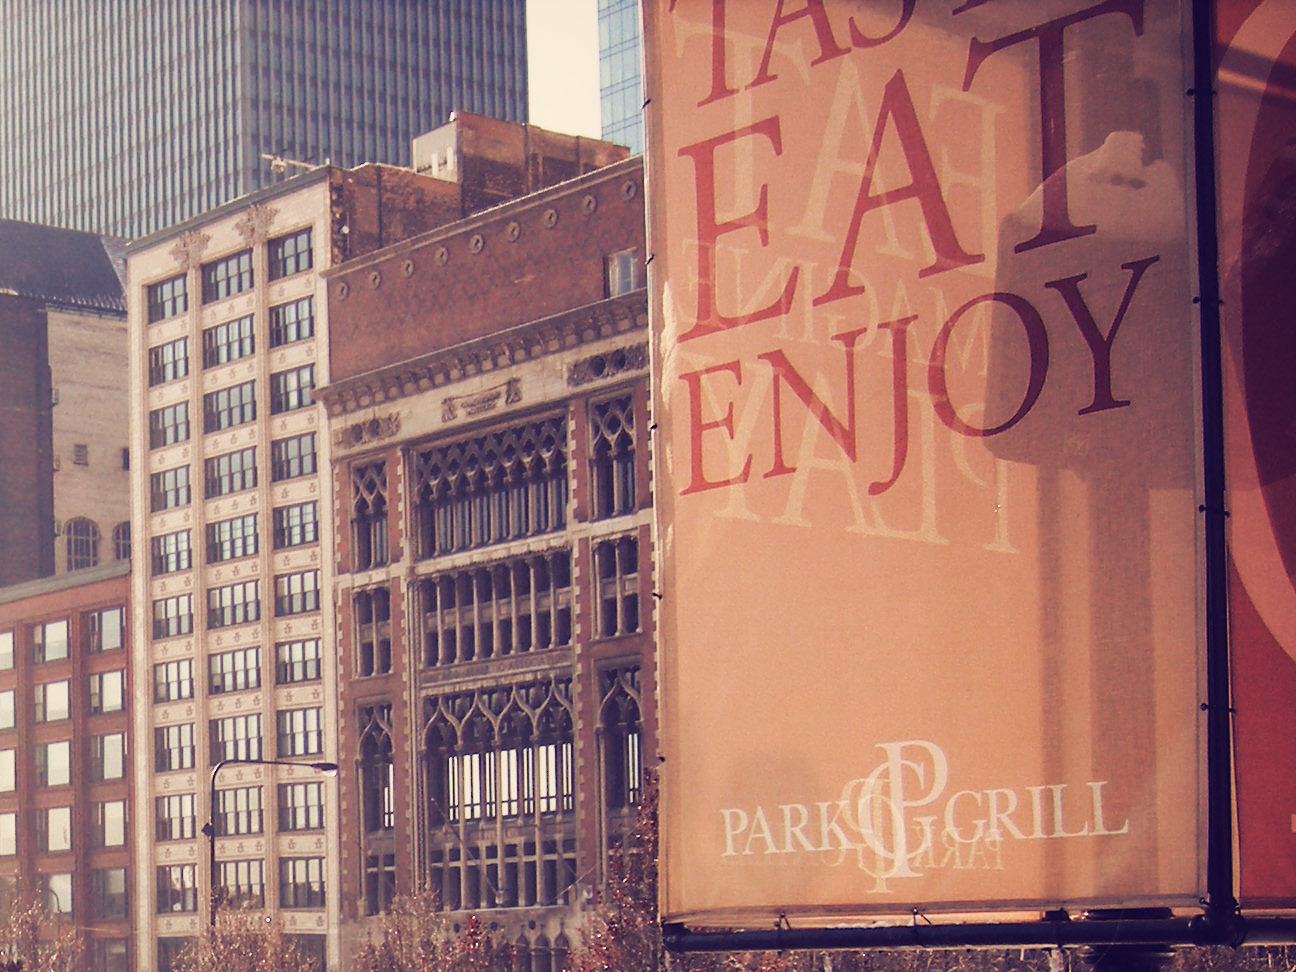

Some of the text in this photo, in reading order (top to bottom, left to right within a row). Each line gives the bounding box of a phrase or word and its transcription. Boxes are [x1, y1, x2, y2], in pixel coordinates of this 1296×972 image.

[677, 1, 1144, 344] EAT
[679, 255, 1161, 496] ENJOY
[720, 801, 858, 858] PARK
[944, 781, 1129, 844] GRILL
